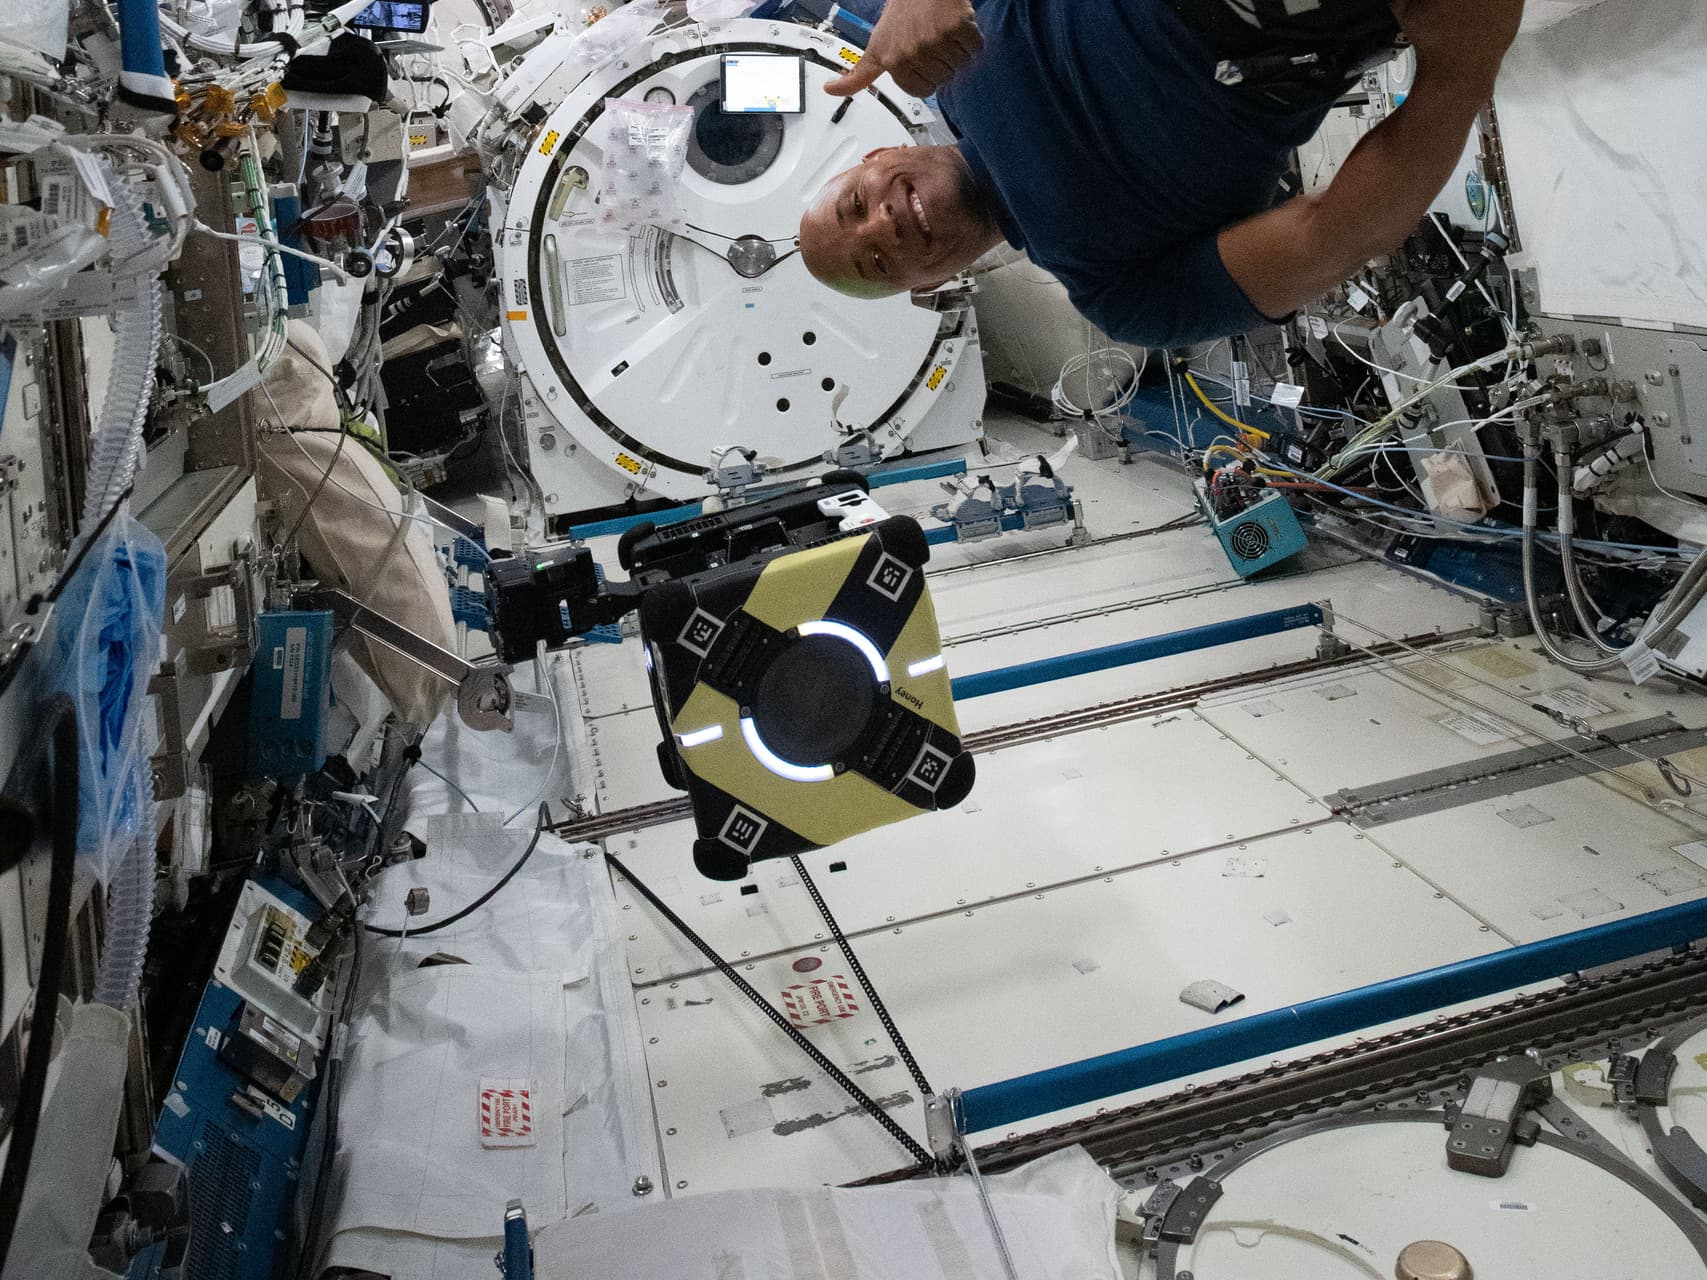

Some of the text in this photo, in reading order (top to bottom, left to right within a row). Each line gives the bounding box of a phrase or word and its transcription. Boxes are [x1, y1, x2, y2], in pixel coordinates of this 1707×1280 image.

[895, 686, 924, 710] Honey
[809, 986, 831, 1017] FIRE PORT
[503, 1098, 511, 1128] FIRE PORT
